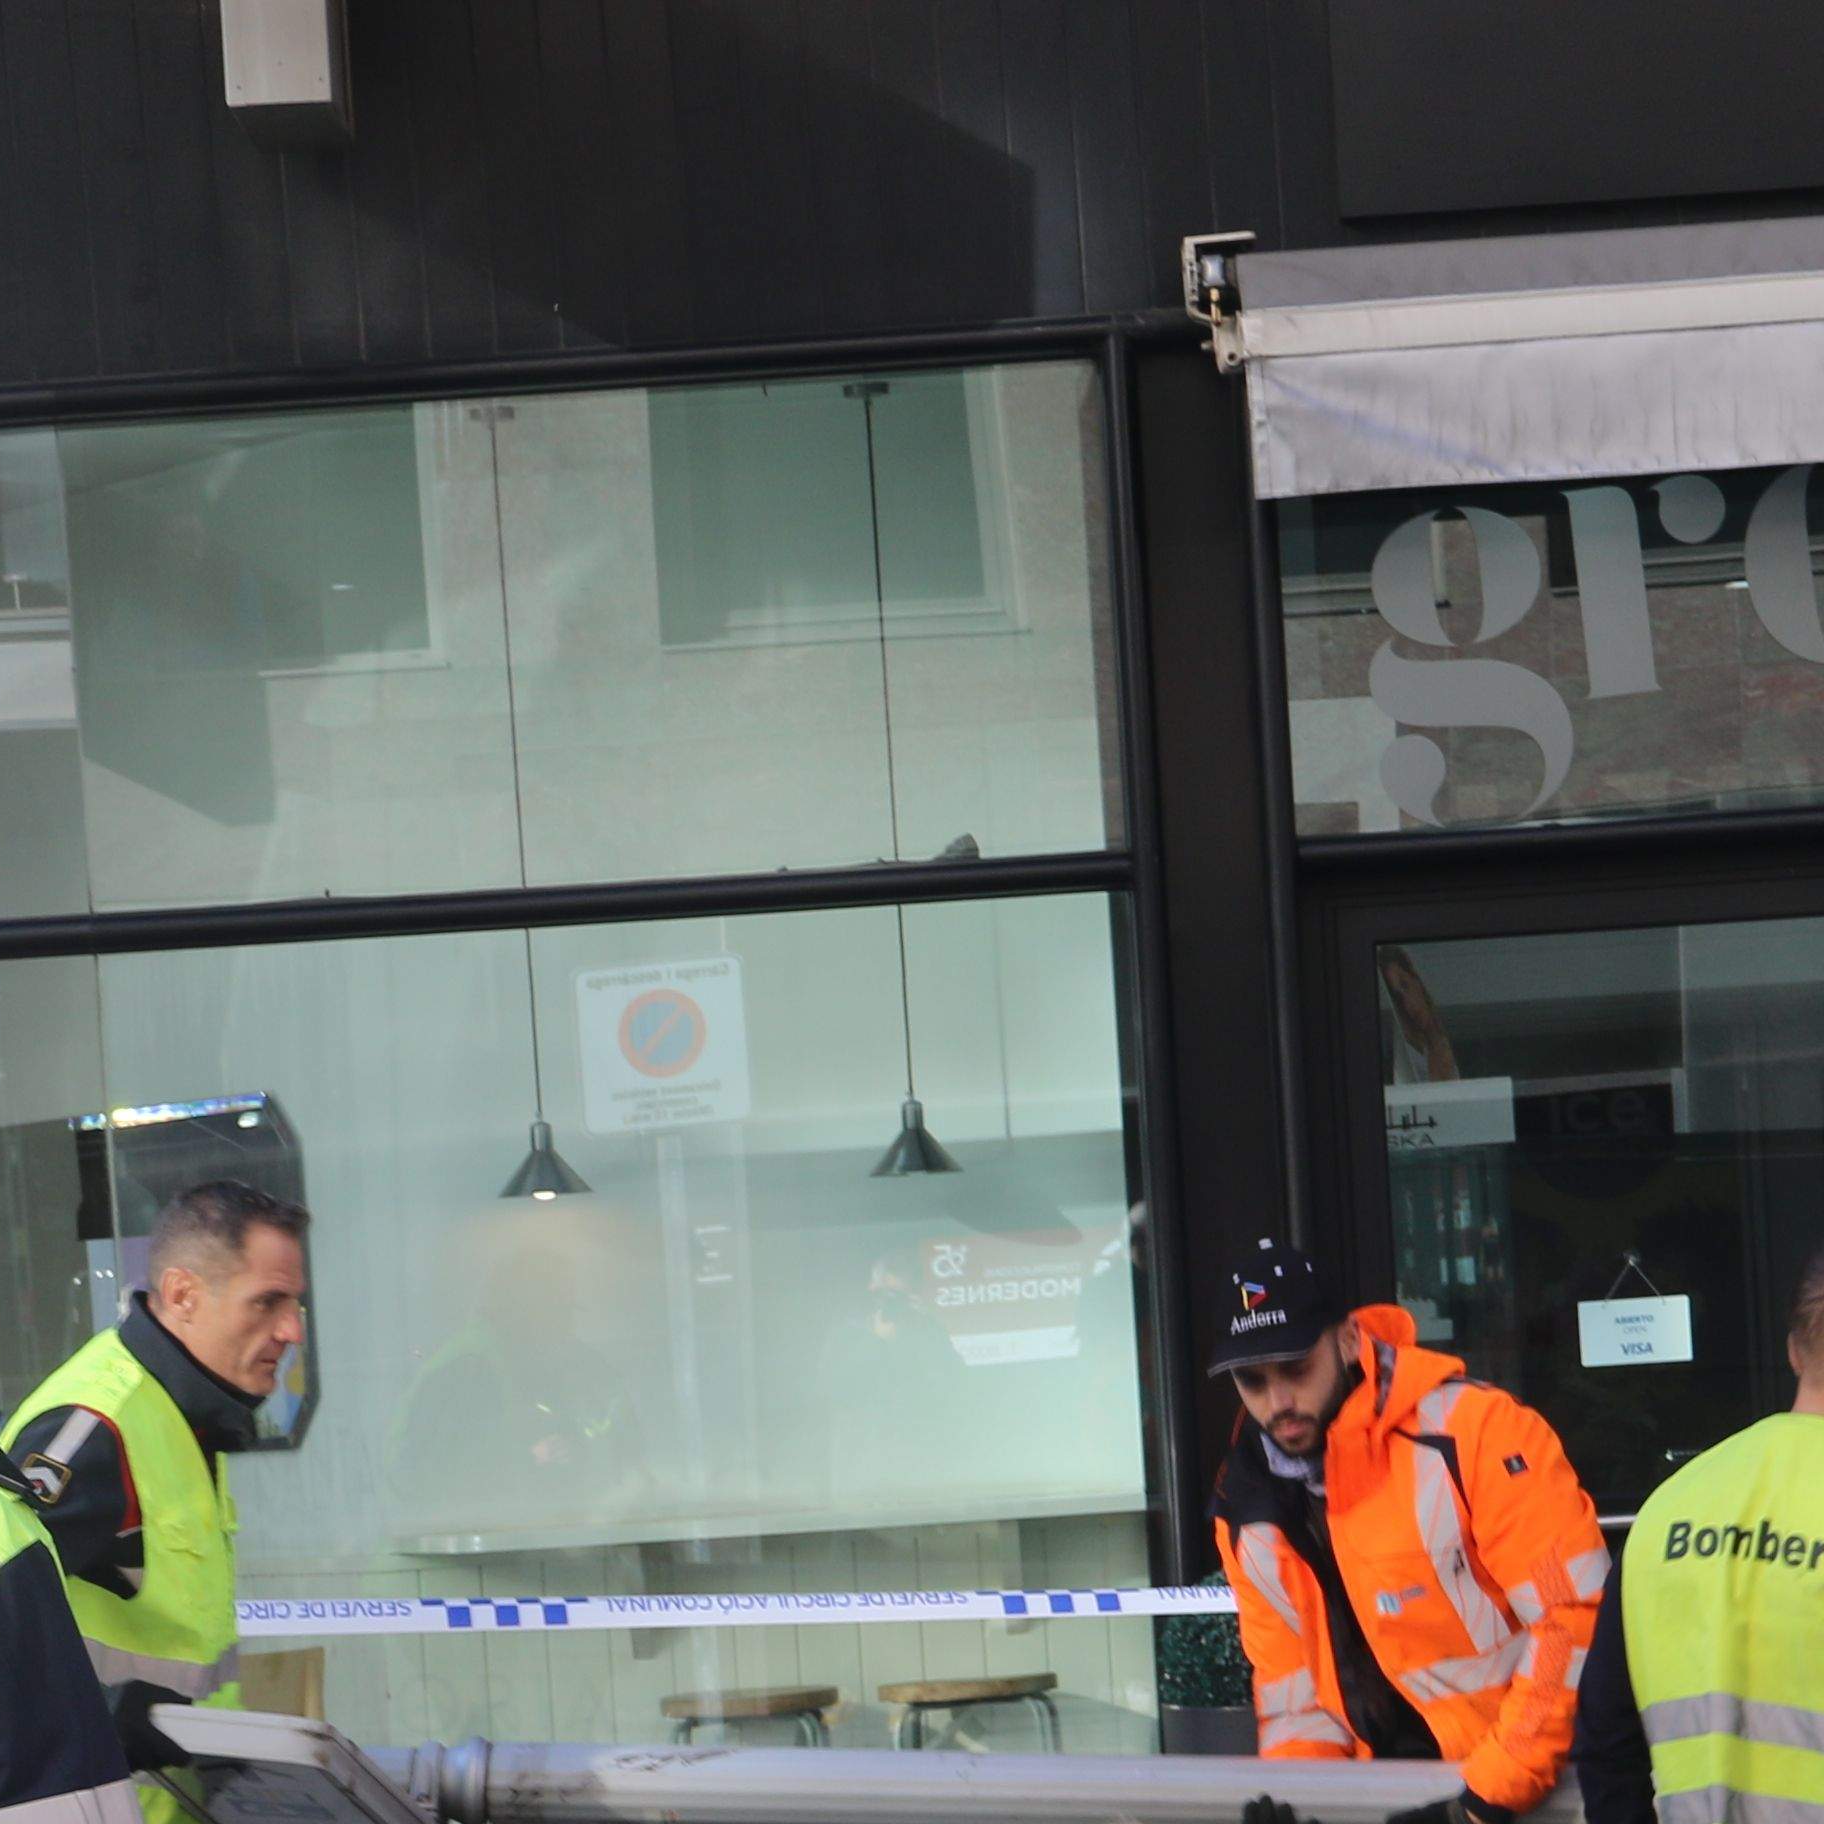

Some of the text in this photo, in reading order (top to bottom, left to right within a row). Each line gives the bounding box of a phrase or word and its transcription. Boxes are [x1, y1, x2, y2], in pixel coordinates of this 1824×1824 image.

[1230, 1308, 1288, 1336] Andorra
[1620, 1342, 1654, 1356] VISA
[236, 1601, 292, 1621] CIRC
